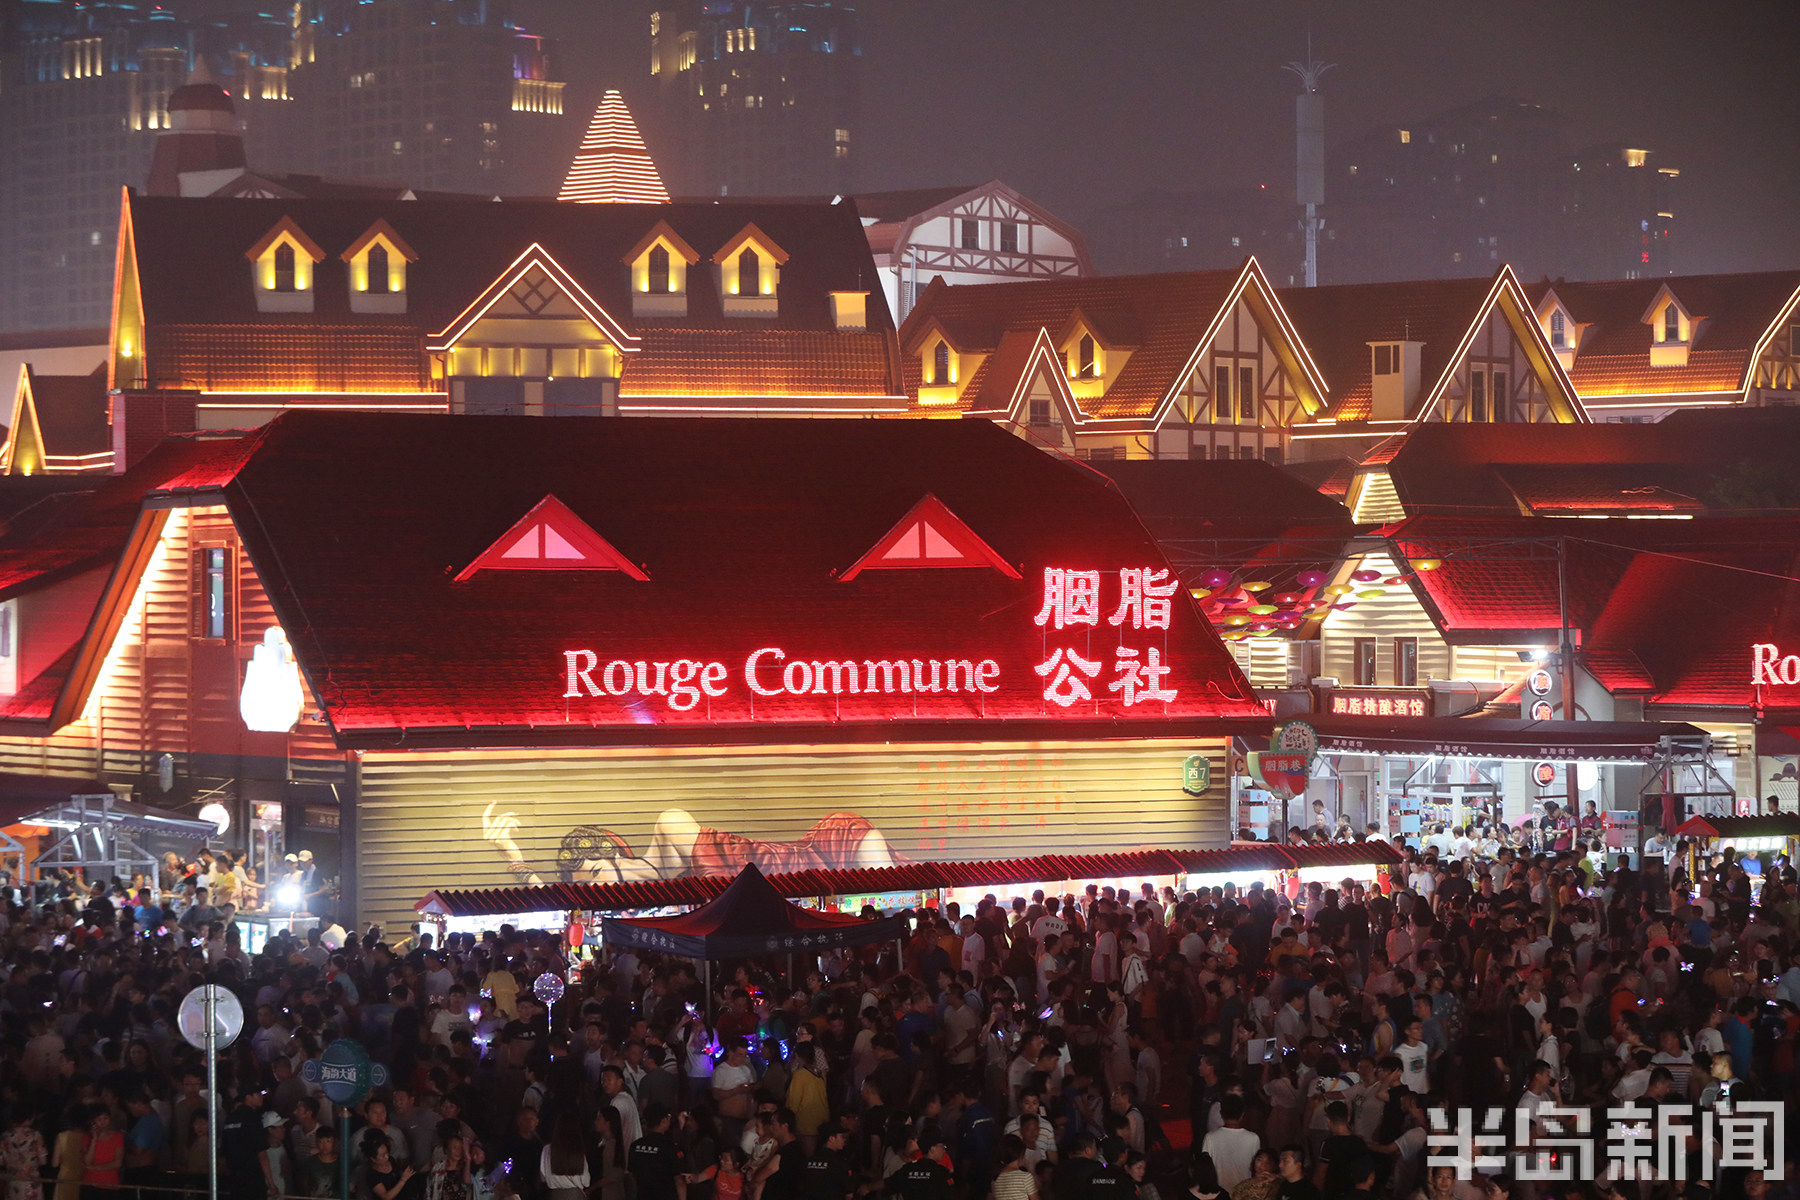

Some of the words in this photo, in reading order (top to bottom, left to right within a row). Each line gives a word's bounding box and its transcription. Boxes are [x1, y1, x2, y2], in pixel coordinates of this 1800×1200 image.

[1034, 565, 1179, 630] 胭脂
[562, 648, 728, 712] Rouge
[744, 647, 1001, 697] Commune
[1033, 646, 1179, 707] 公社
[1332, 696, 1425, 717] 胭脂精酿酒馆
[1264, 759, 1303, 772] 胭脂巷
